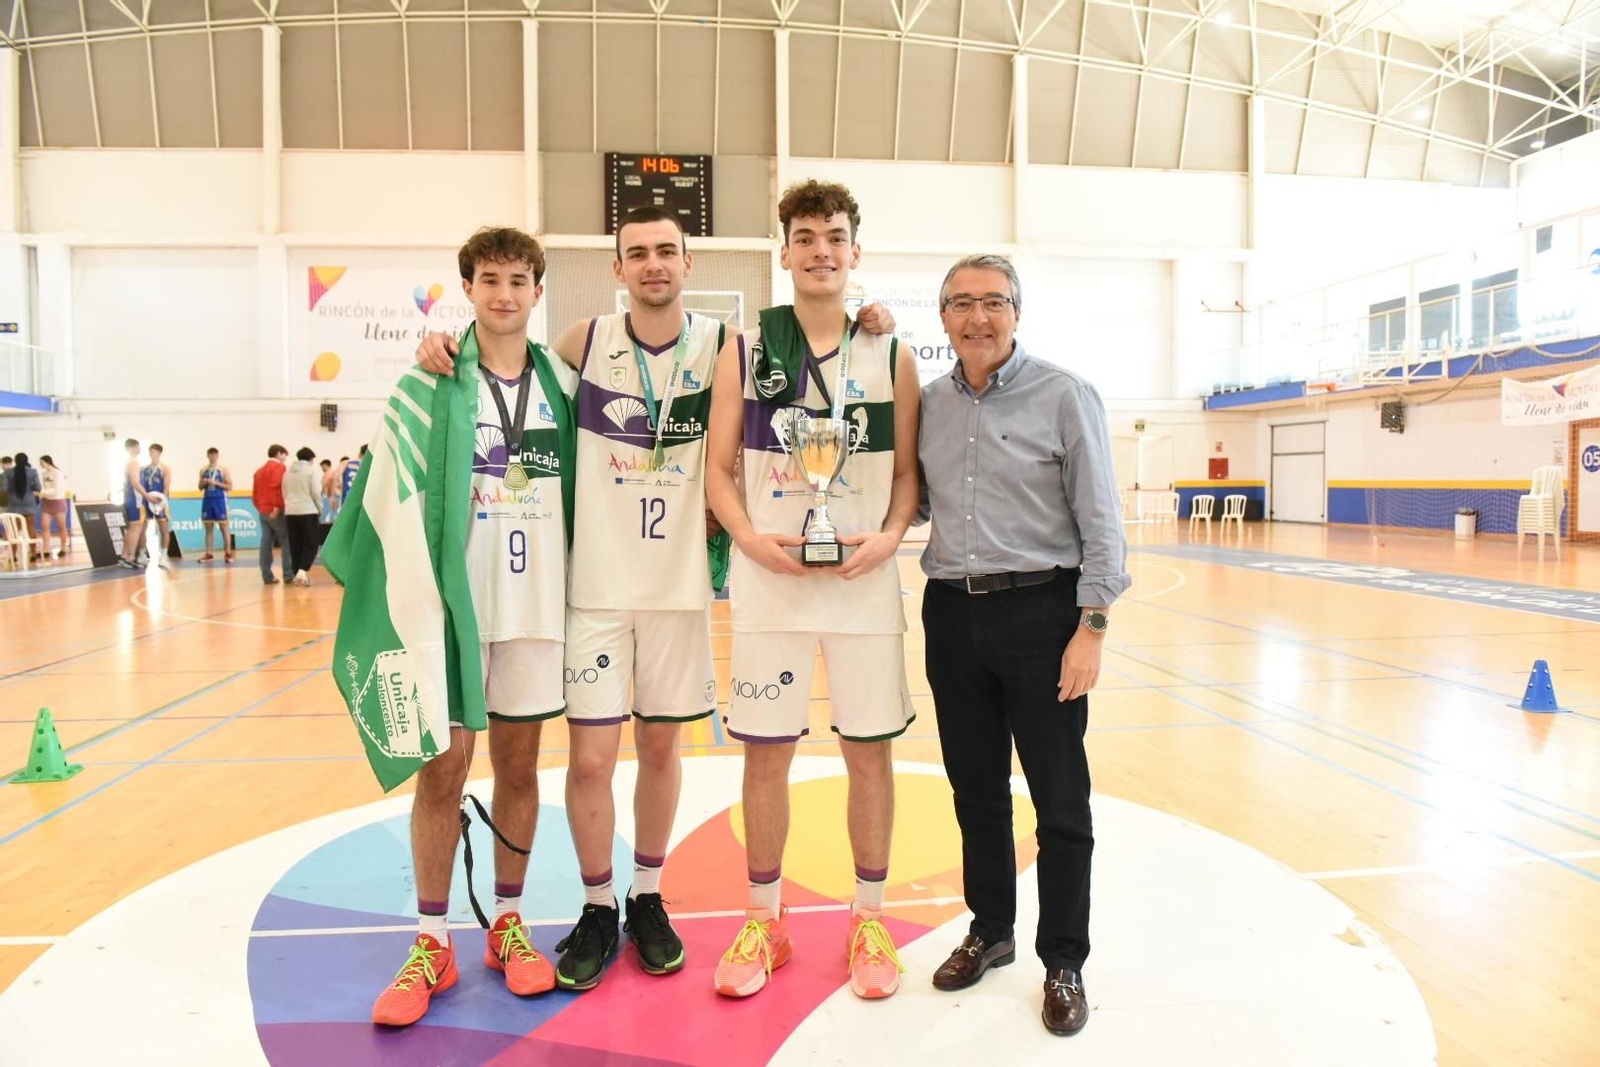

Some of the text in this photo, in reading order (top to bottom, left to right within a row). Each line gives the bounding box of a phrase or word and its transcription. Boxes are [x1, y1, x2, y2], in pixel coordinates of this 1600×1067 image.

[319, 302, 375, 318] RINCÓN
[380, 305, 397, 318] de
[402, 305, 414, 318] la
[519, 446, 560, 469] nicaja
[1584, 451, 1600, 466] 05
[172, 518, 202, 530] azul
[640, 498, 665, 539] 12
[509, 530, 526, 573] 9
[390, 672, 410, 734] Unicaja
